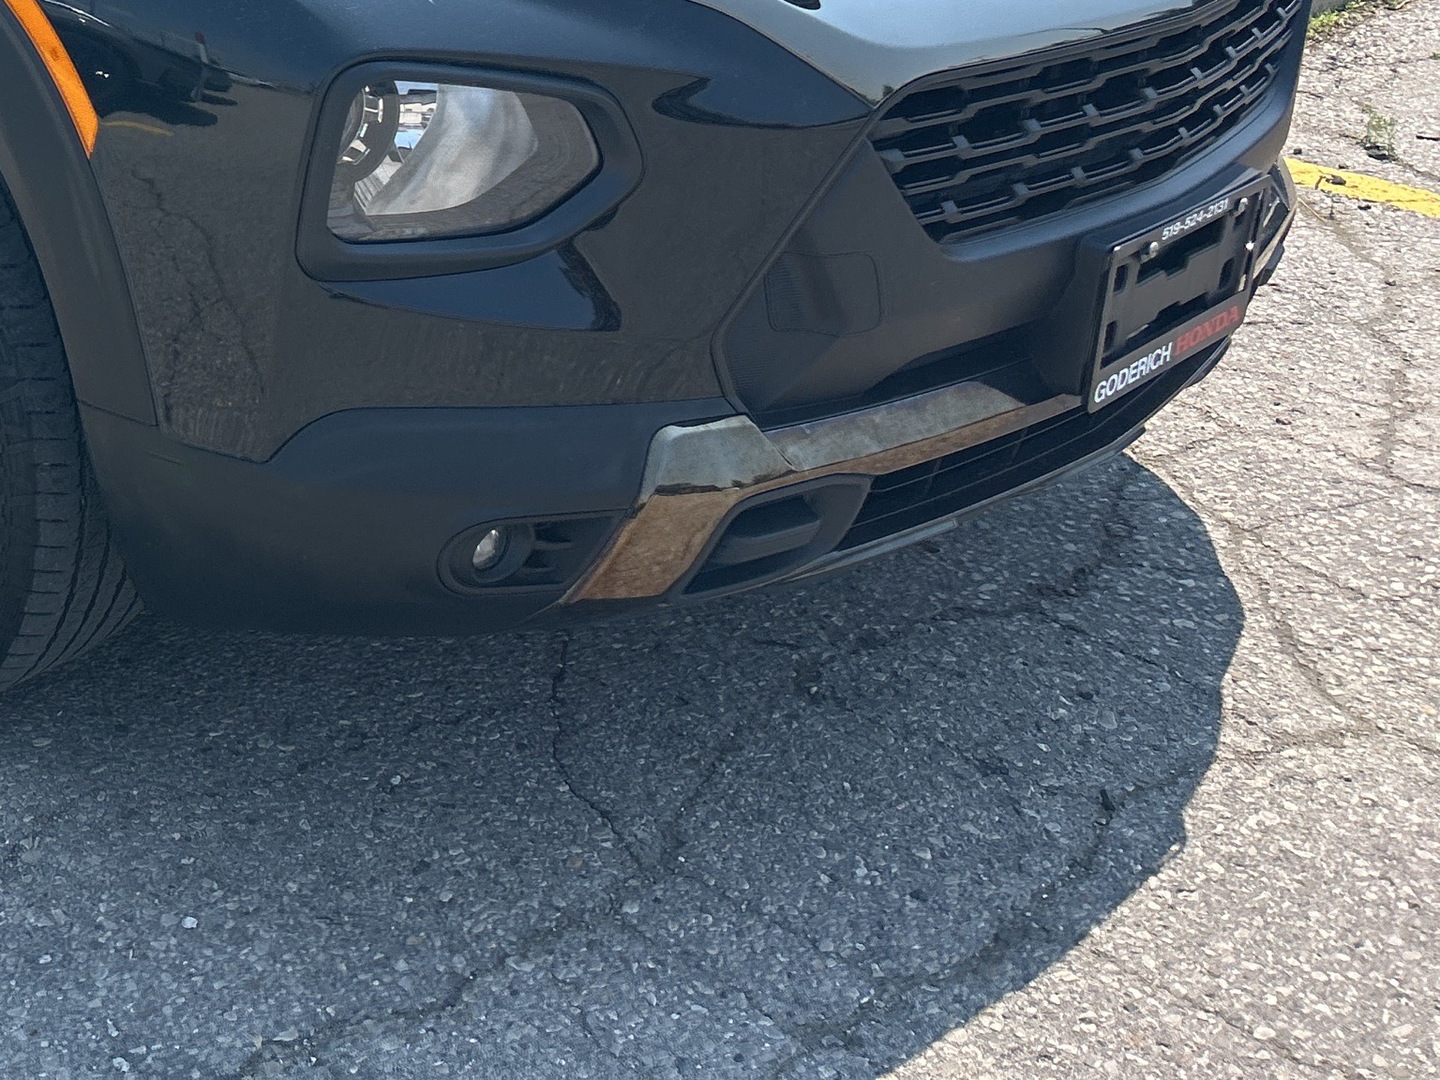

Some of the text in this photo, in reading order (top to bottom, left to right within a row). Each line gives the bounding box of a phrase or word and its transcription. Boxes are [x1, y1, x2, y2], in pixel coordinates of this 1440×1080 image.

[1161, 197, 1229, 241] 519-524-2131
[1093, 305, 1240, 403] GODERICH HONDA
